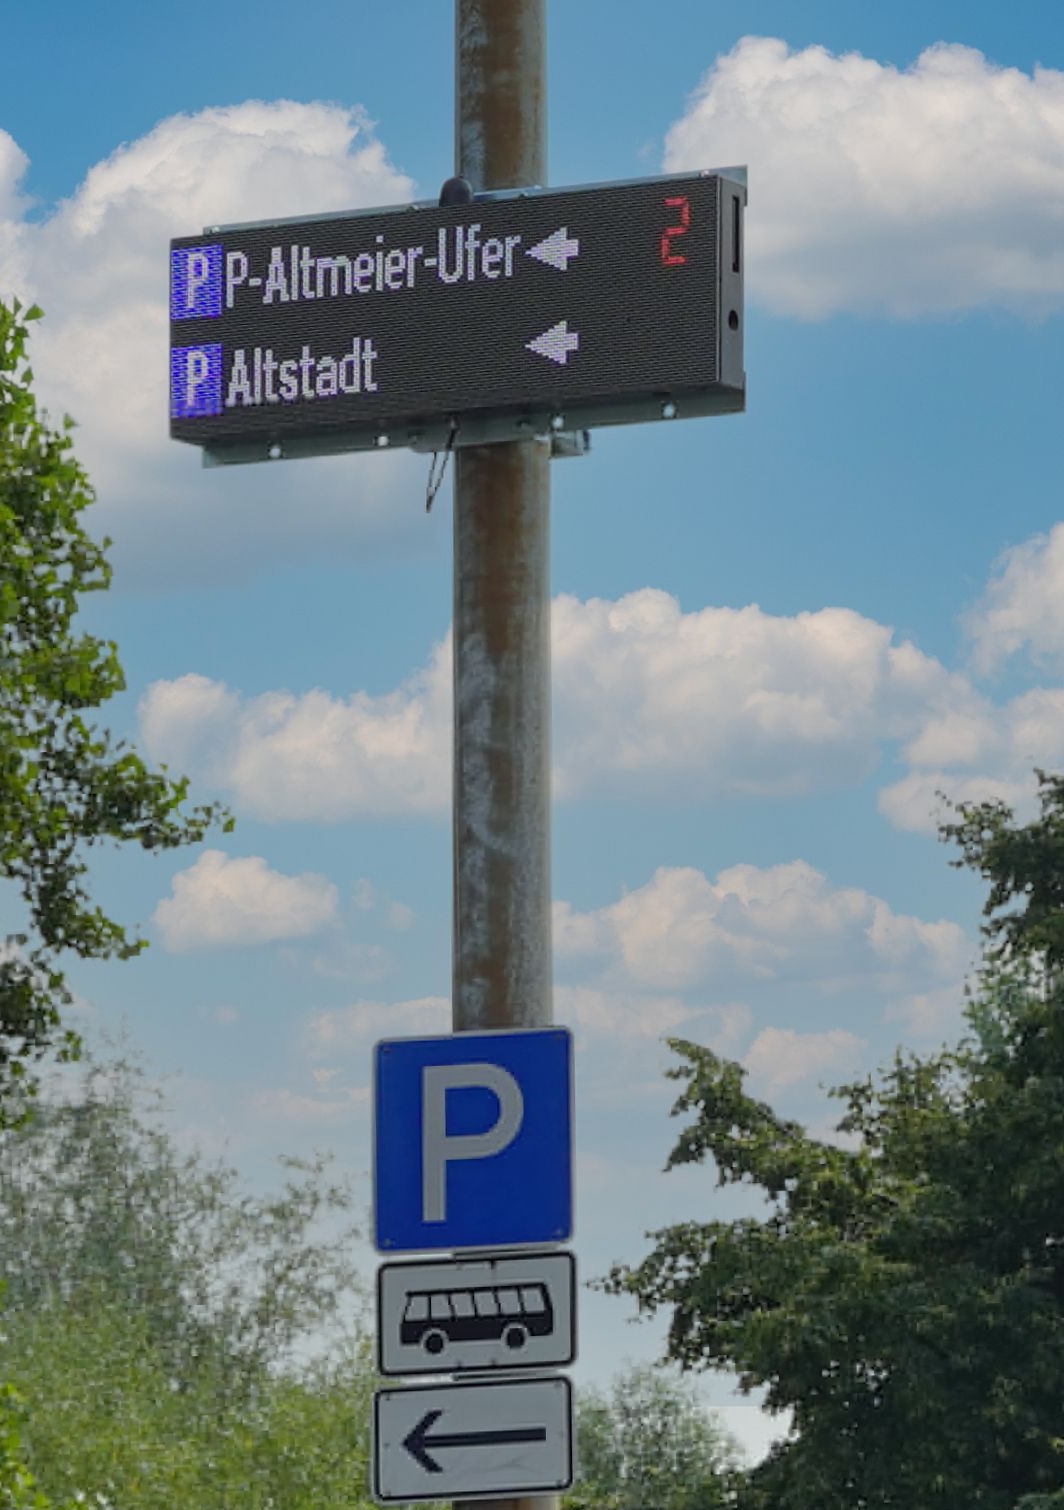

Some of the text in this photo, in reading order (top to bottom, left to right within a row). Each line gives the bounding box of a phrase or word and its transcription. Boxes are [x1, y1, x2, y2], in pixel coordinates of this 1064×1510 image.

[186, 197, 691, 309] P P-Altmeier-Ufer 2
[186, 337, 379, 407] P Altstadt
[422, 1062, 524, 1223] P
